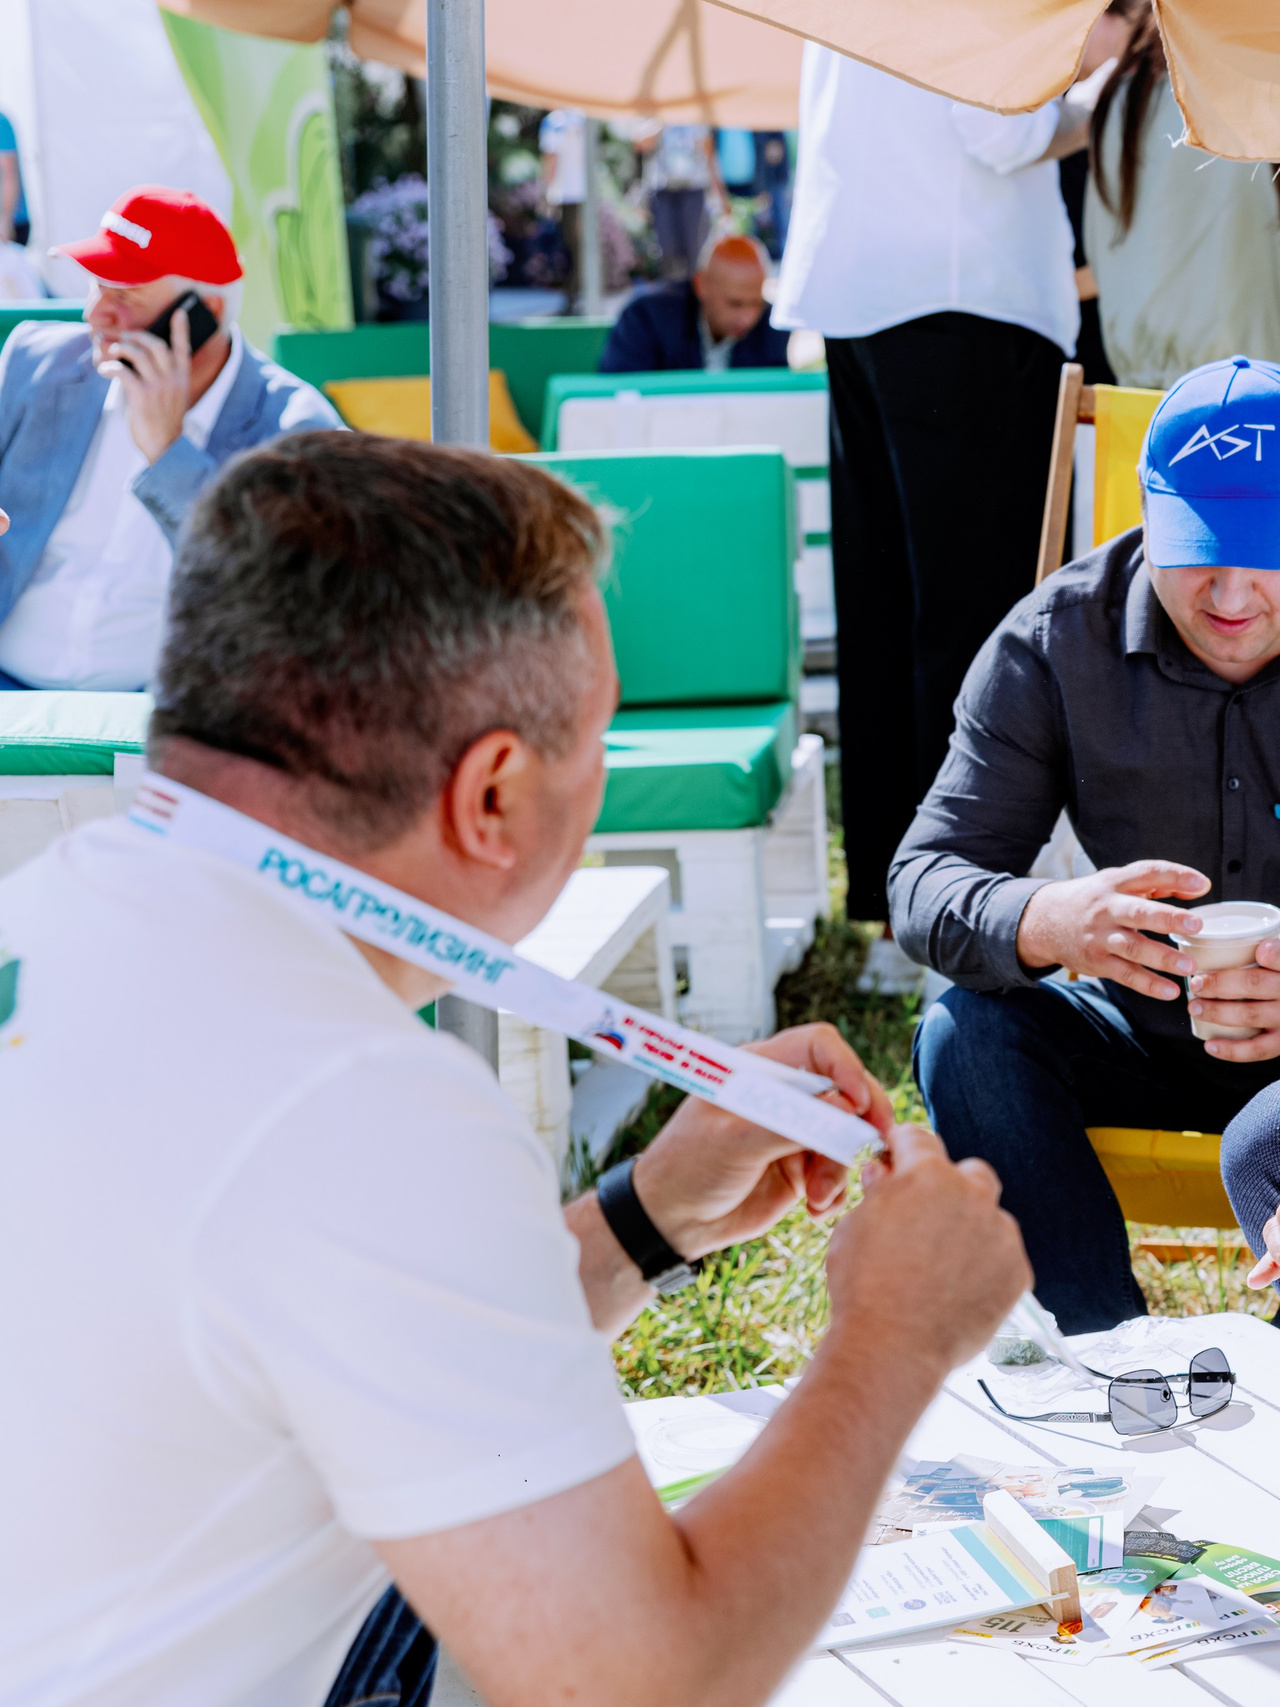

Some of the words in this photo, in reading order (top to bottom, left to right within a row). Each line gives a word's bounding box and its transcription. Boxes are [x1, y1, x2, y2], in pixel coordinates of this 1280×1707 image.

[1168, 424, 1276, 467] AST
[257, 845, 518, 986] РОСАГРОЛИЗИНГ
[1077, 1573, 1148, 1585] СВО
[979, 1617, 1027, 1633] 115
